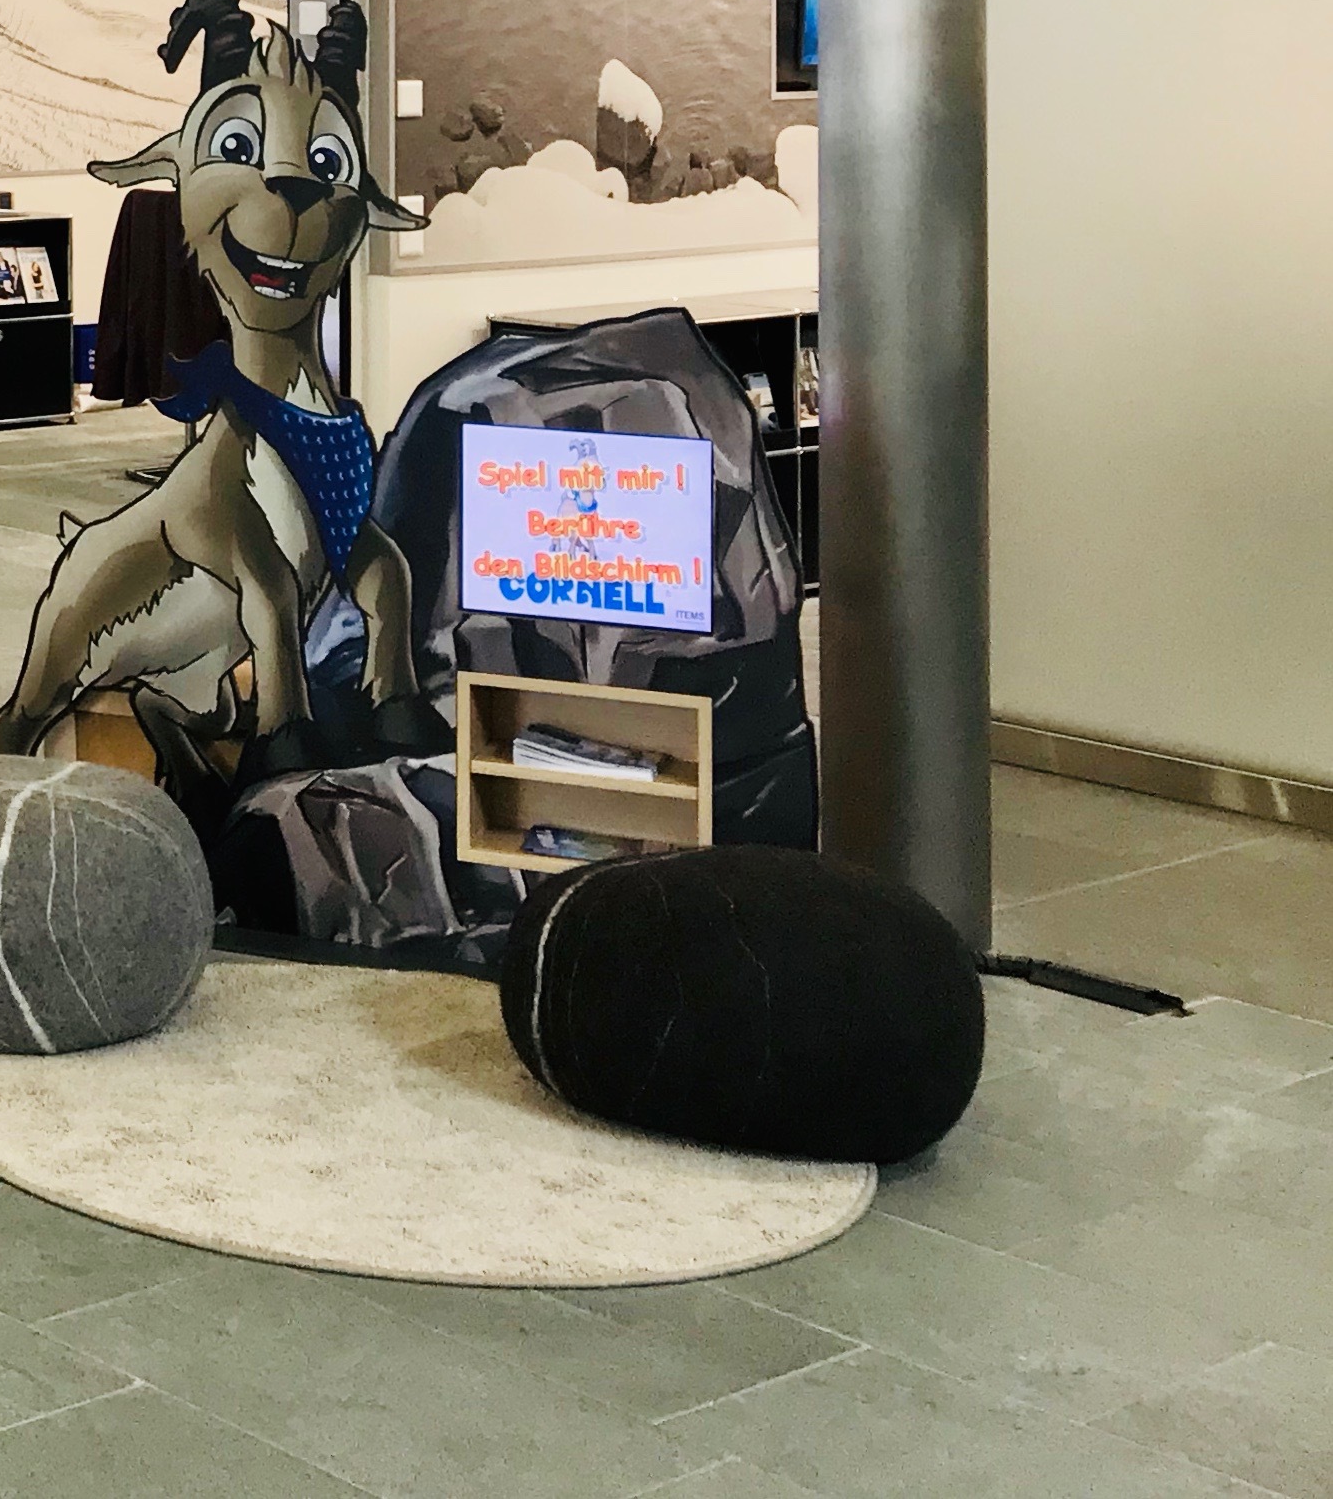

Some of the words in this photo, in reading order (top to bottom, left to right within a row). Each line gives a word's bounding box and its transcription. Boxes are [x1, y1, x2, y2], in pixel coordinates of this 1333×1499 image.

[477, 461, 546, 494] Spiel
[559, 462, 604, 489] mit
[617, 464, 663, 491] mir
[676, 463, 685, 491] !
[527, 510, 641, 541] Berühre
[473, 552, 523, 579] den
[535, 552, 682, 585] Bildschirm
[693, 557, 703, 585] !
[499, 574, 665, 615] CORNELL
